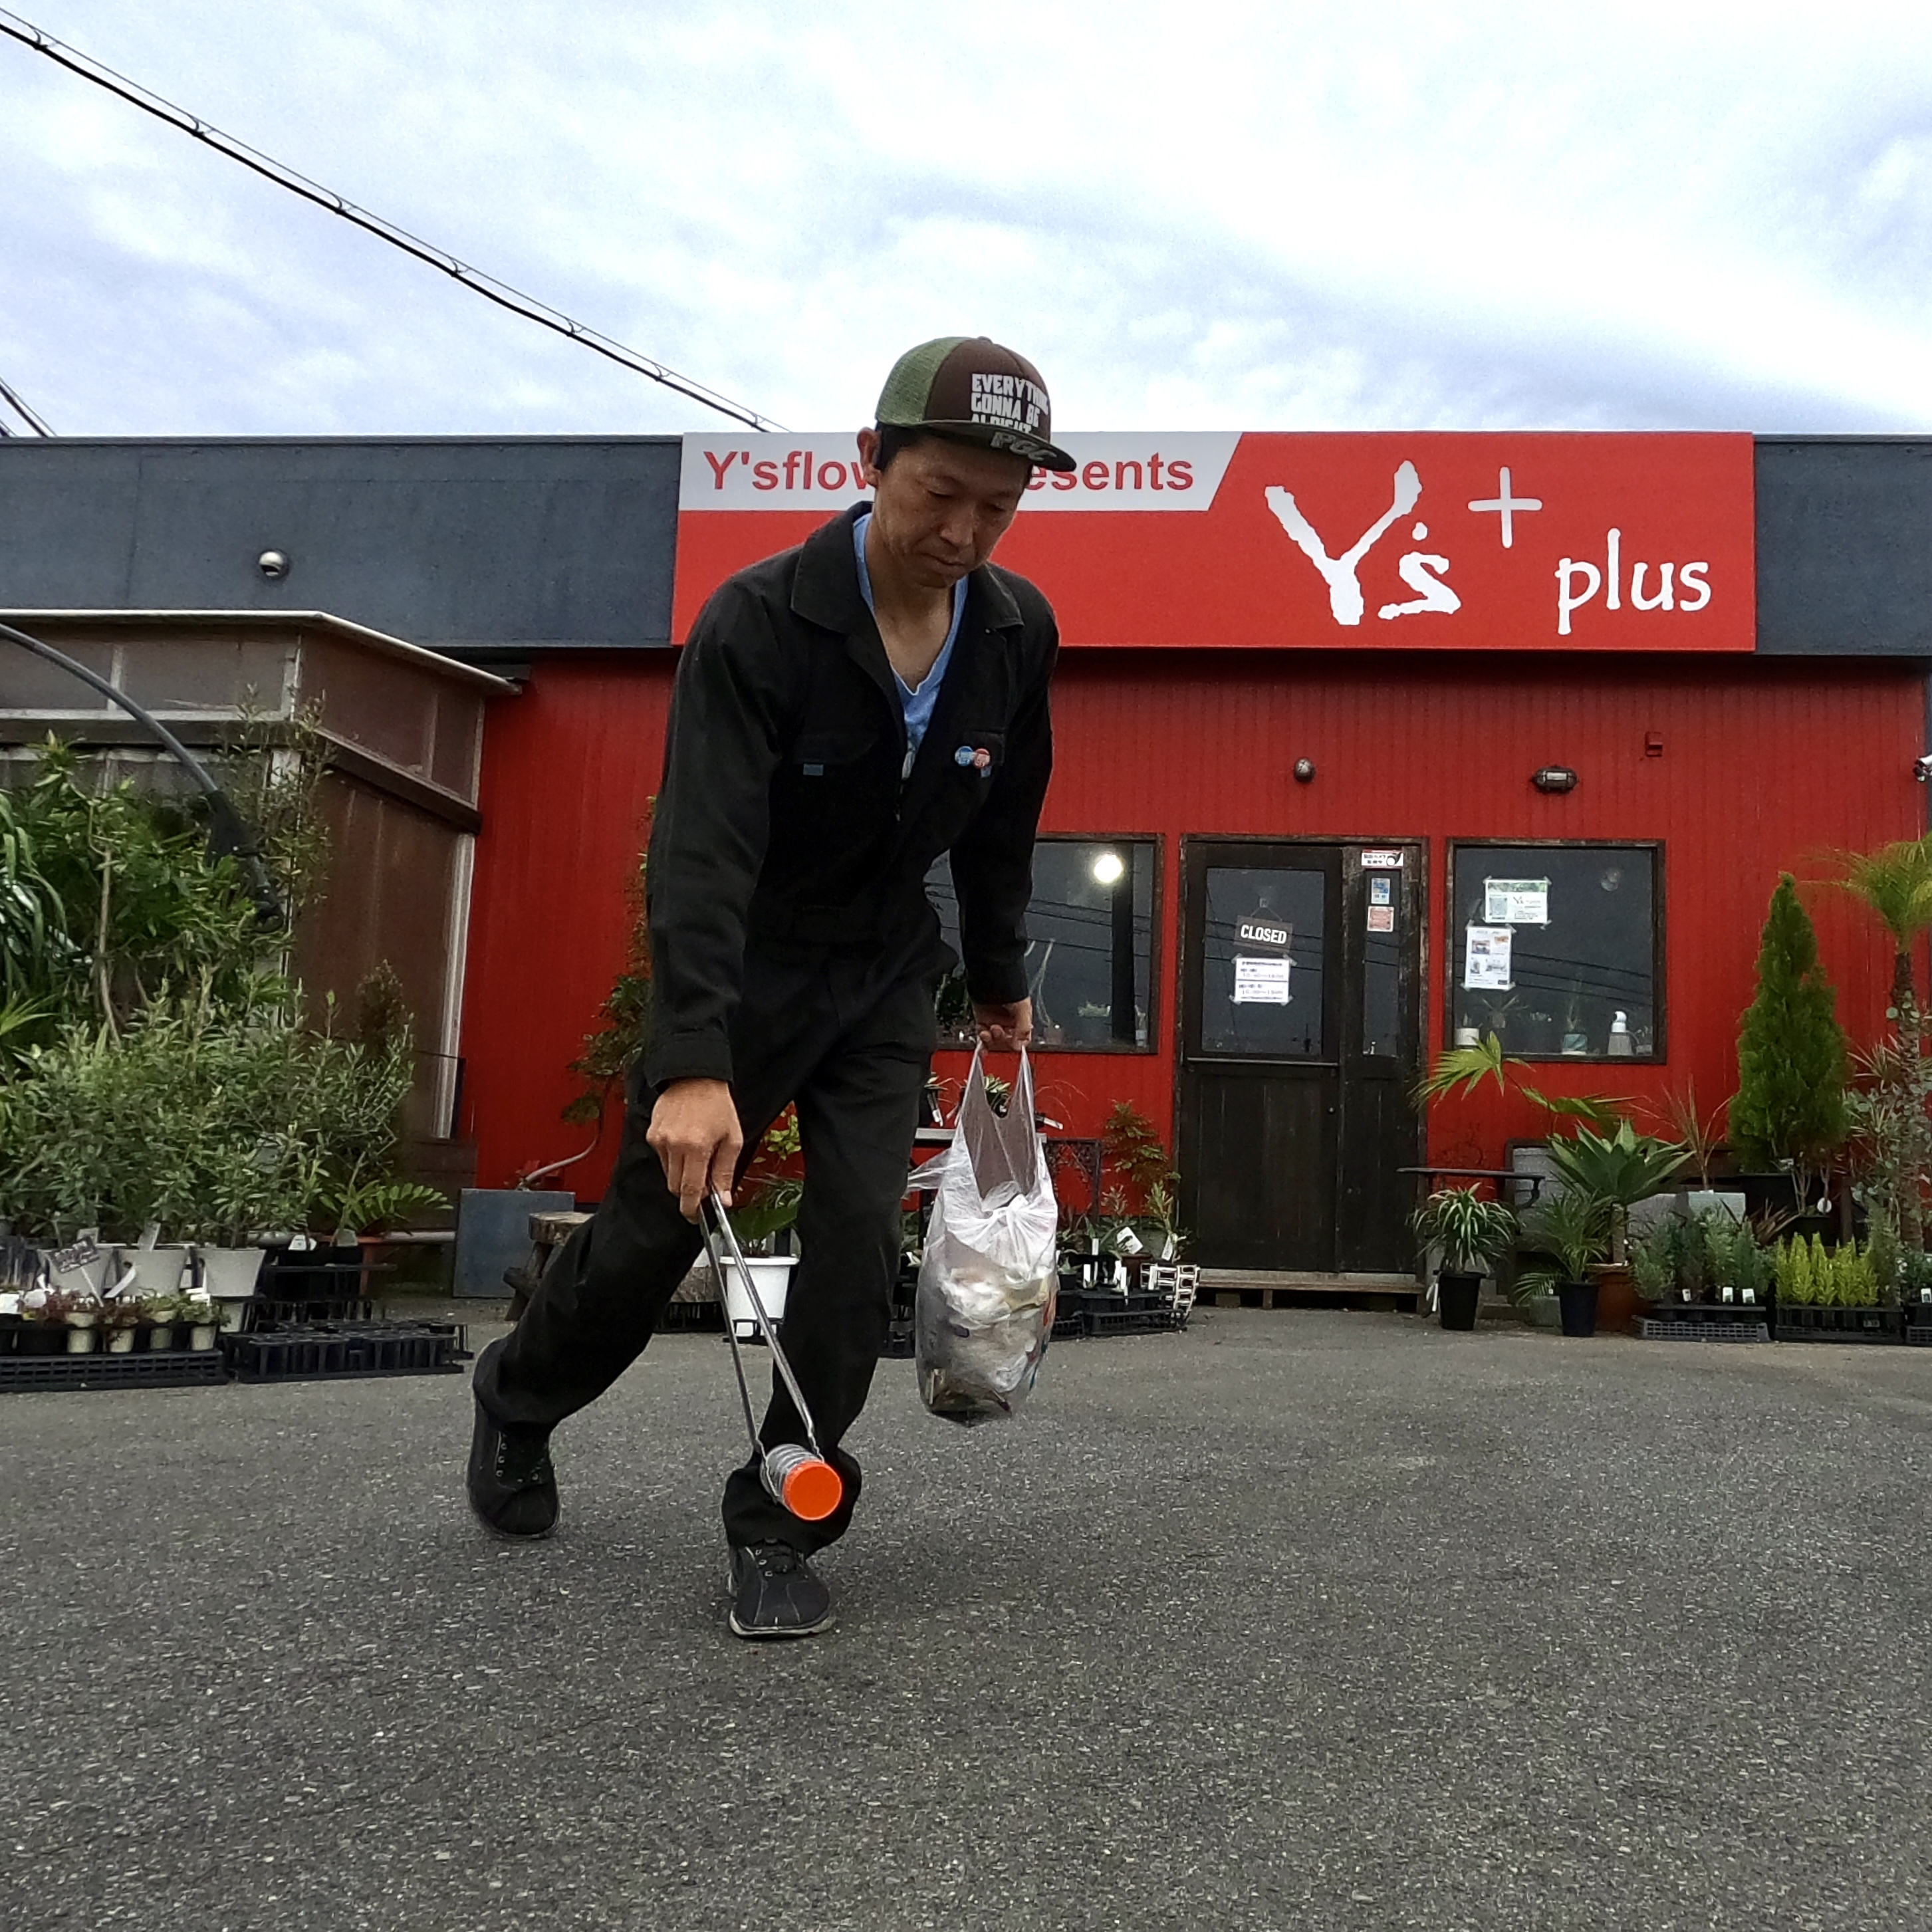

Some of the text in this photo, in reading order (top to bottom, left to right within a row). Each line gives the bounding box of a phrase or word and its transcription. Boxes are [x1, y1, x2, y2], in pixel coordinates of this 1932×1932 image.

[971, 393, 1040, 427] GONNA BE
[1554, 528, 1711, 634] plus
[1241, 924, 1287, 944] CLOSED
